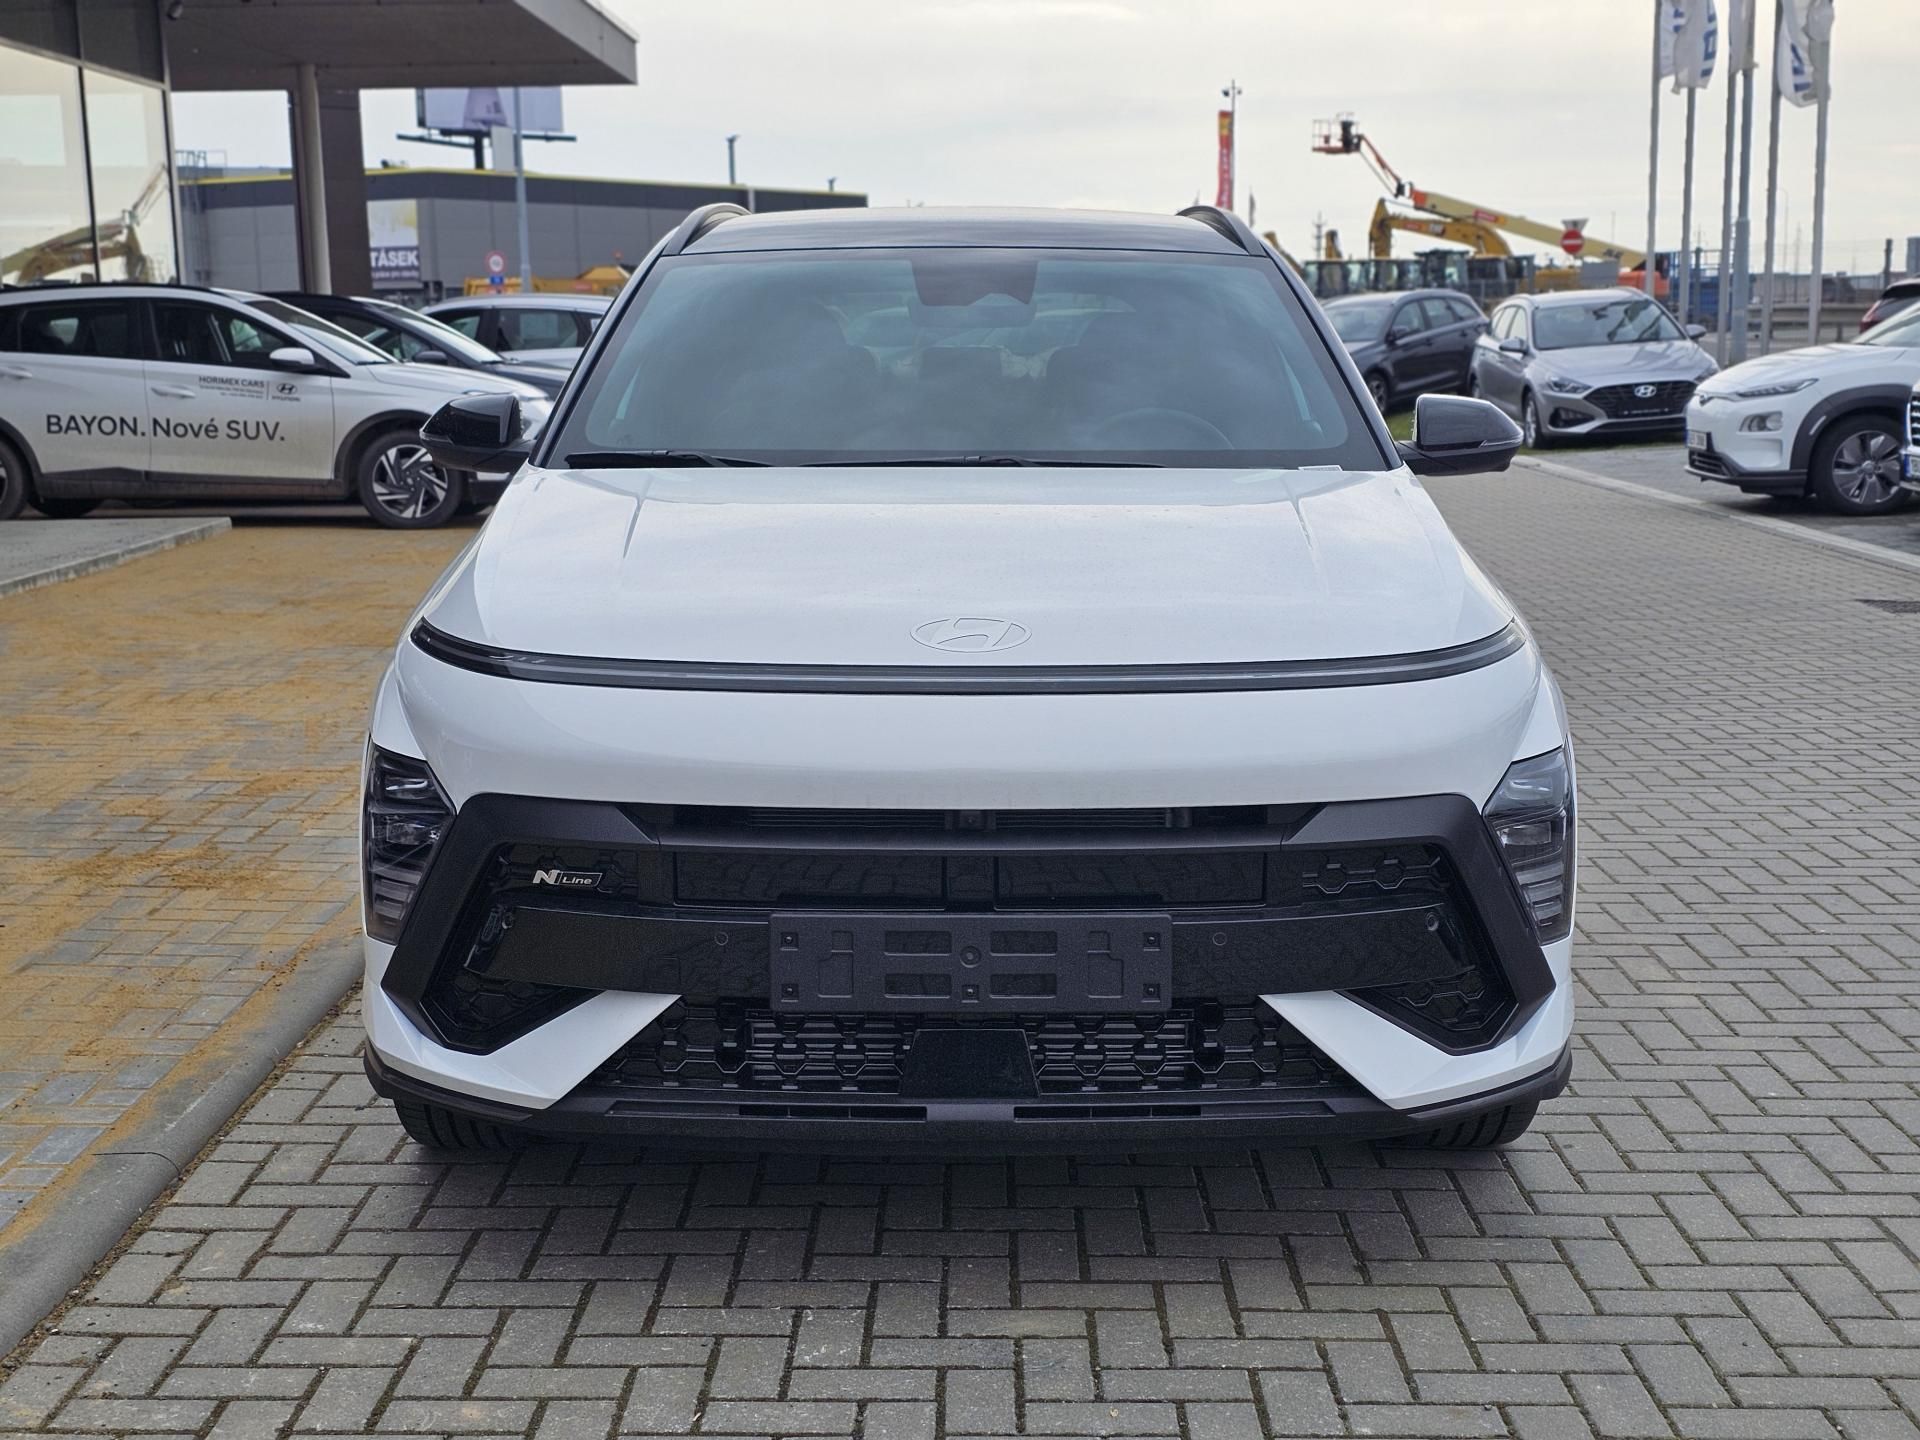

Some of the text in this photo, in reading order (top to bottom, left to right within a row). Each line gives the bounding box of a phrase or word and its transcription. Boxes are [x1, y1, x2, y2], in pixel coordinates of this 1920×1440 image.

[241, 379, 264, 388] CARS
[46, 414, 286, 441] BAYON. Nové SUV.
[532, 869, 592, 885] N Line
